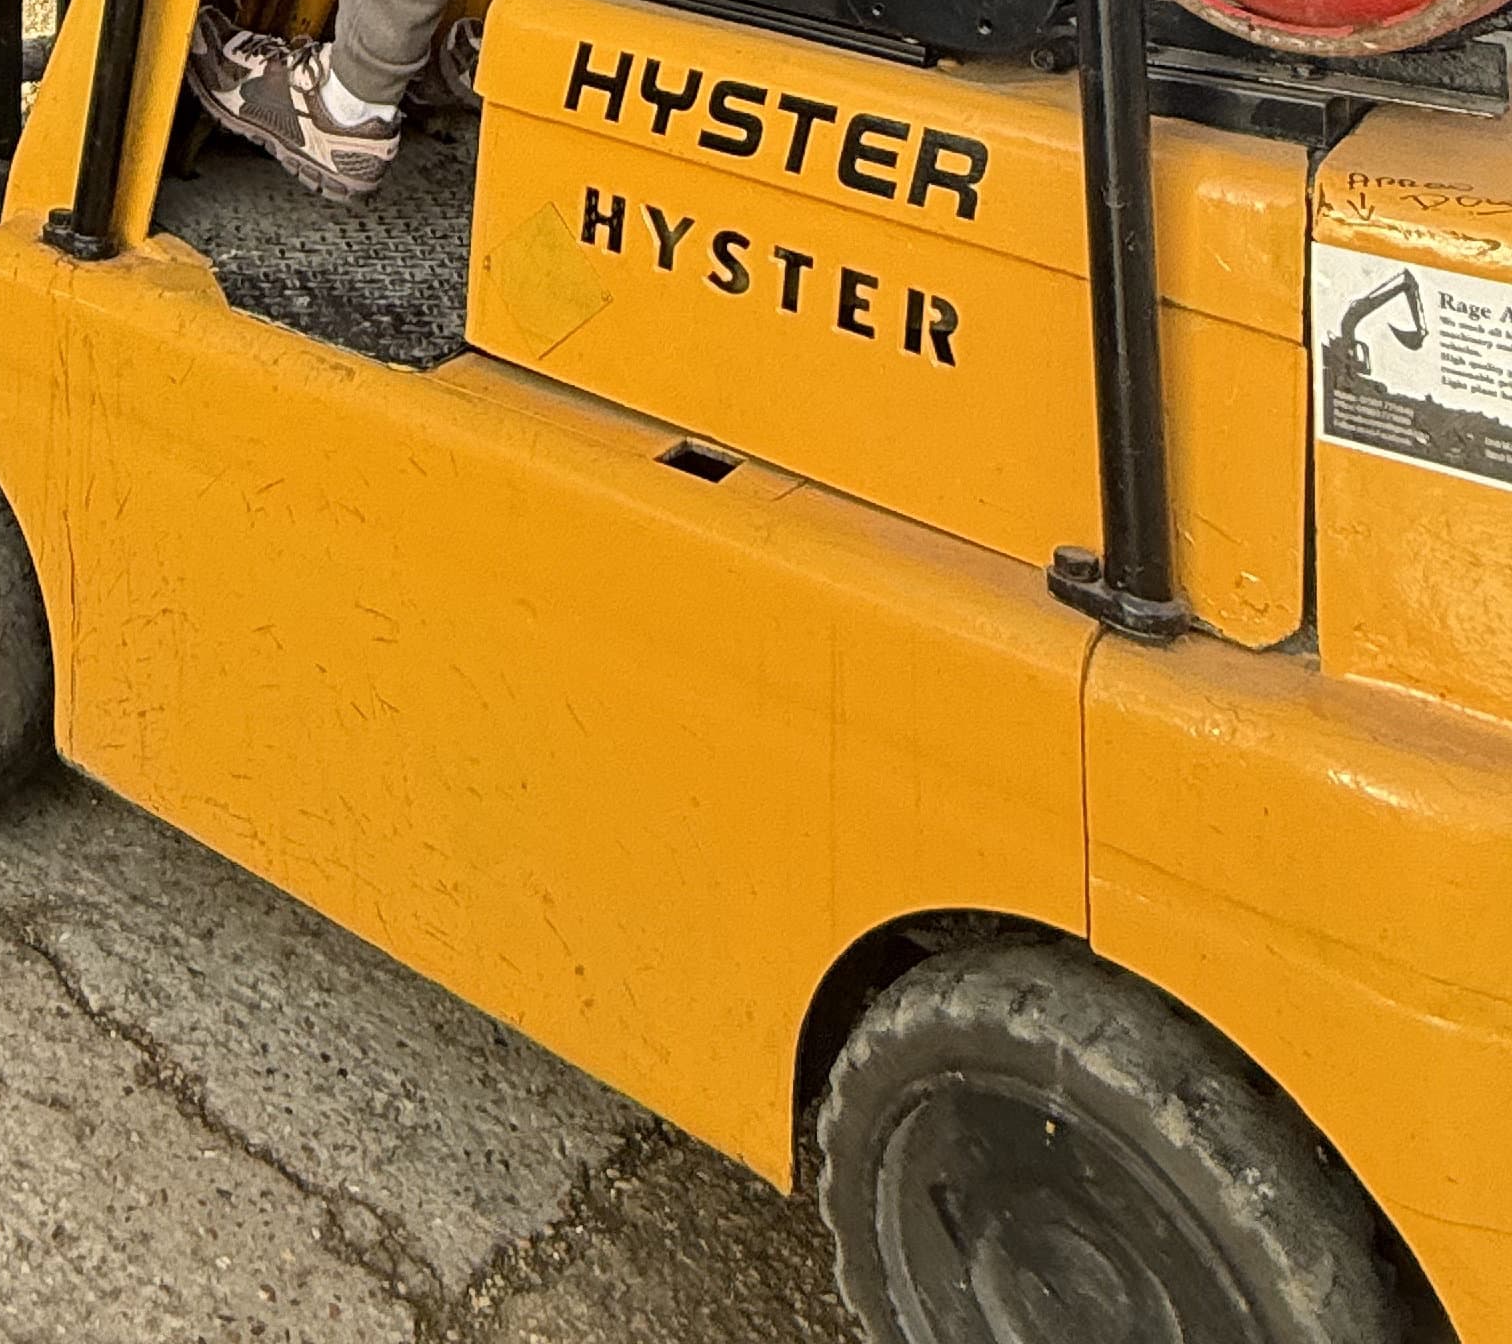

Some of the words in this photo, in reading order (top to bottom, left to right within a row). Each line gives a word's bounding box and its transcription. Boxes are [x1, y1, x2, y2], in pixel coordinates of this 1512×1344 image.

[564, 41, 989, 221] HYSTER
[581, 186, 960, 368] HYSTER
[1438, 291, 1492, 322] Rage
